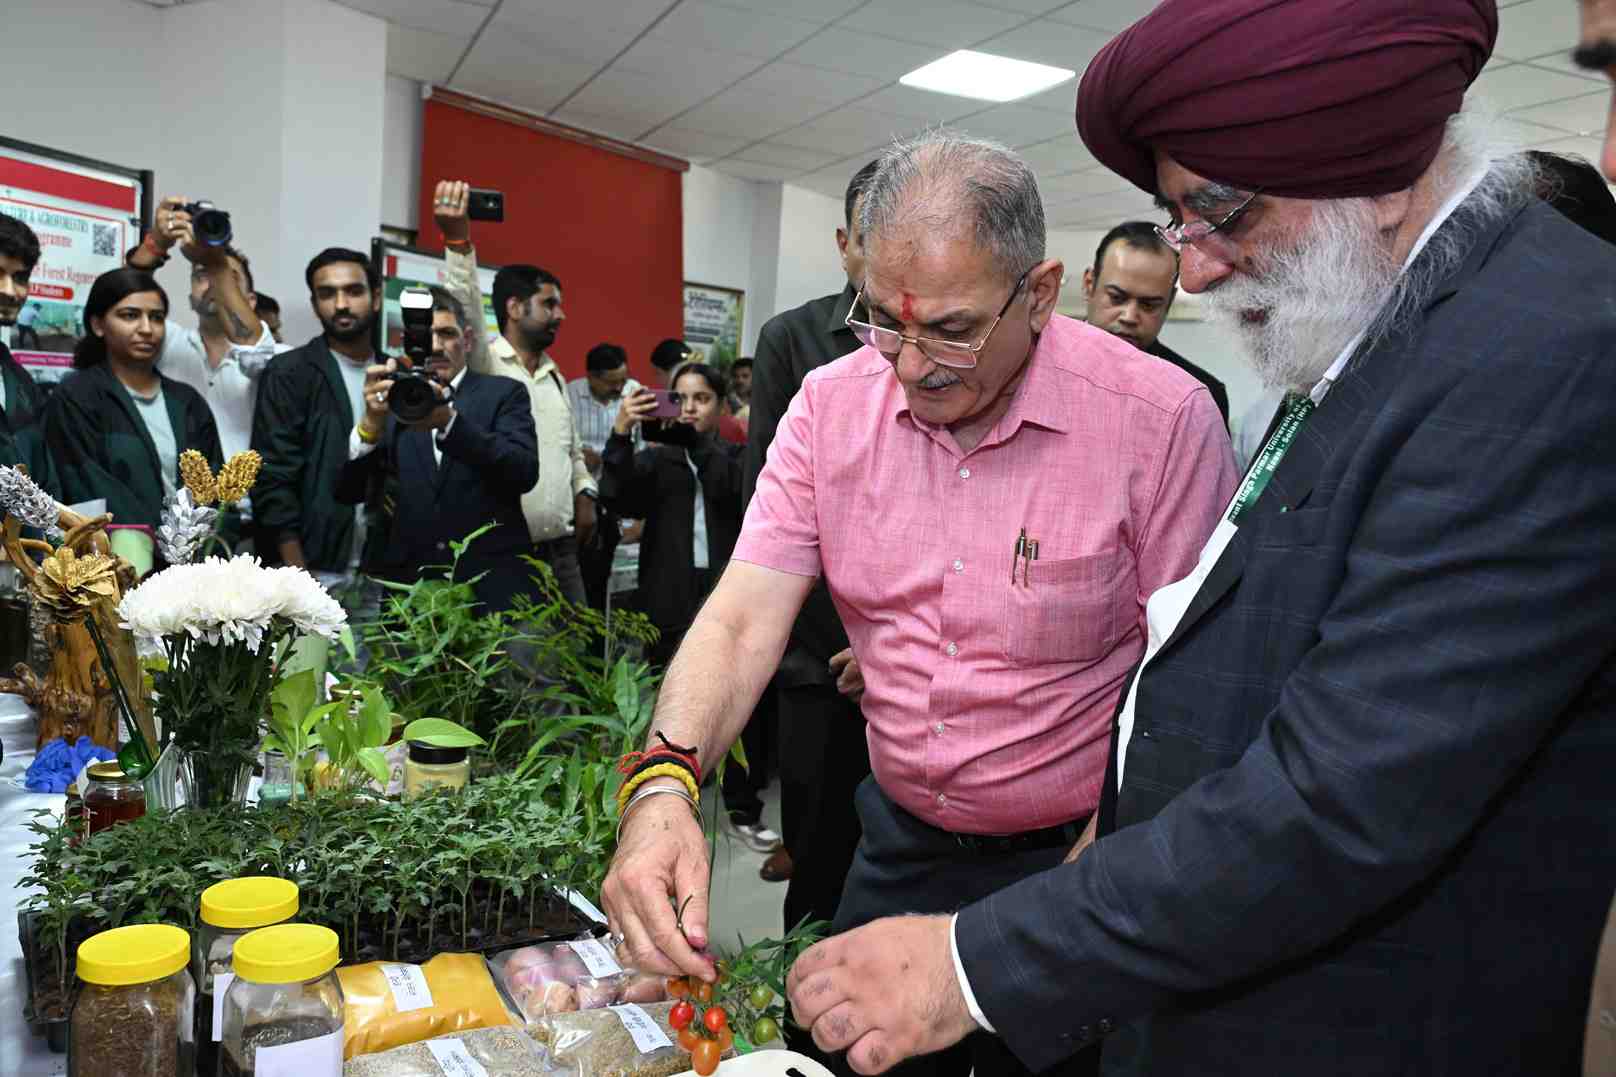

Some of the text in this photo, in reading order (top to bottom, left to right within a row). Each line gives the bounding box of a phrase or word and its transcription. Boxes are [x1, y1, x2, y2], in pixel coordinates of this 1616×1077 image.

[1239, 481, 1255, 502] Singh
[1251, 451, 1271, 479] Parmar
[1267, 414, 1295, 450] University
[1282, 418, 1301, 444] Solan
